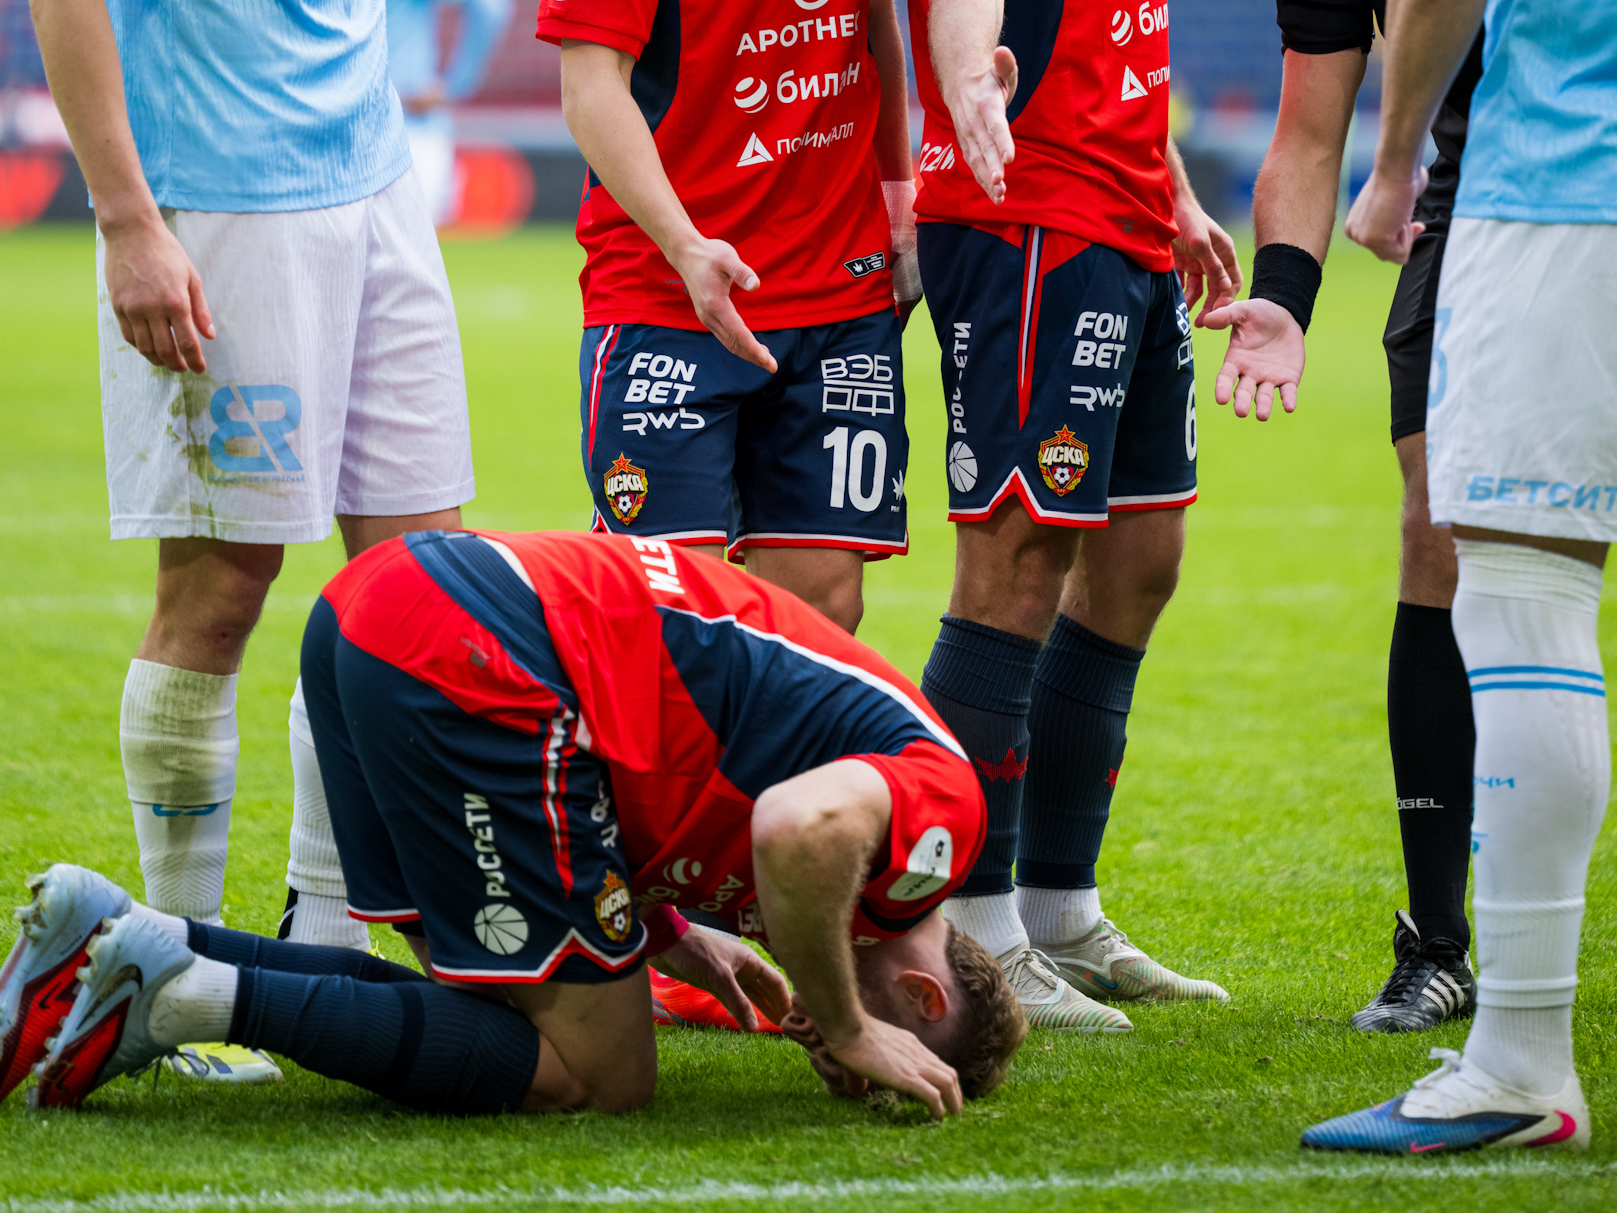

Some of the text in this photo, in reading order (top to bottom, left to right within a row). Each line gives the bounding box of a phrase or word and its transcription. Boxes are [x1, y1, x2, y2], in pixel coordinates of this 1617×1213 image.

[1073, 310, 1129, 342] FON
[628, 352, 698, 383] FON
[821, 353, 894, 382] ВЭБ
[1071, 340, 1127, 370] BET
[623, 378, 696, 405] BET
[822, 426, 888, 512] 10
[1040, 445, 1086, 466] ЦСКА
[208, 473, 305, 484] ENGINEERING
[606, 473, 645, 497] ЦСКА
[1466, 475, 1617, 512] БЕТСИТ
[629, 536, 686, 595] ЕТИ
[600, 888, 631, 921] ЦСКА
